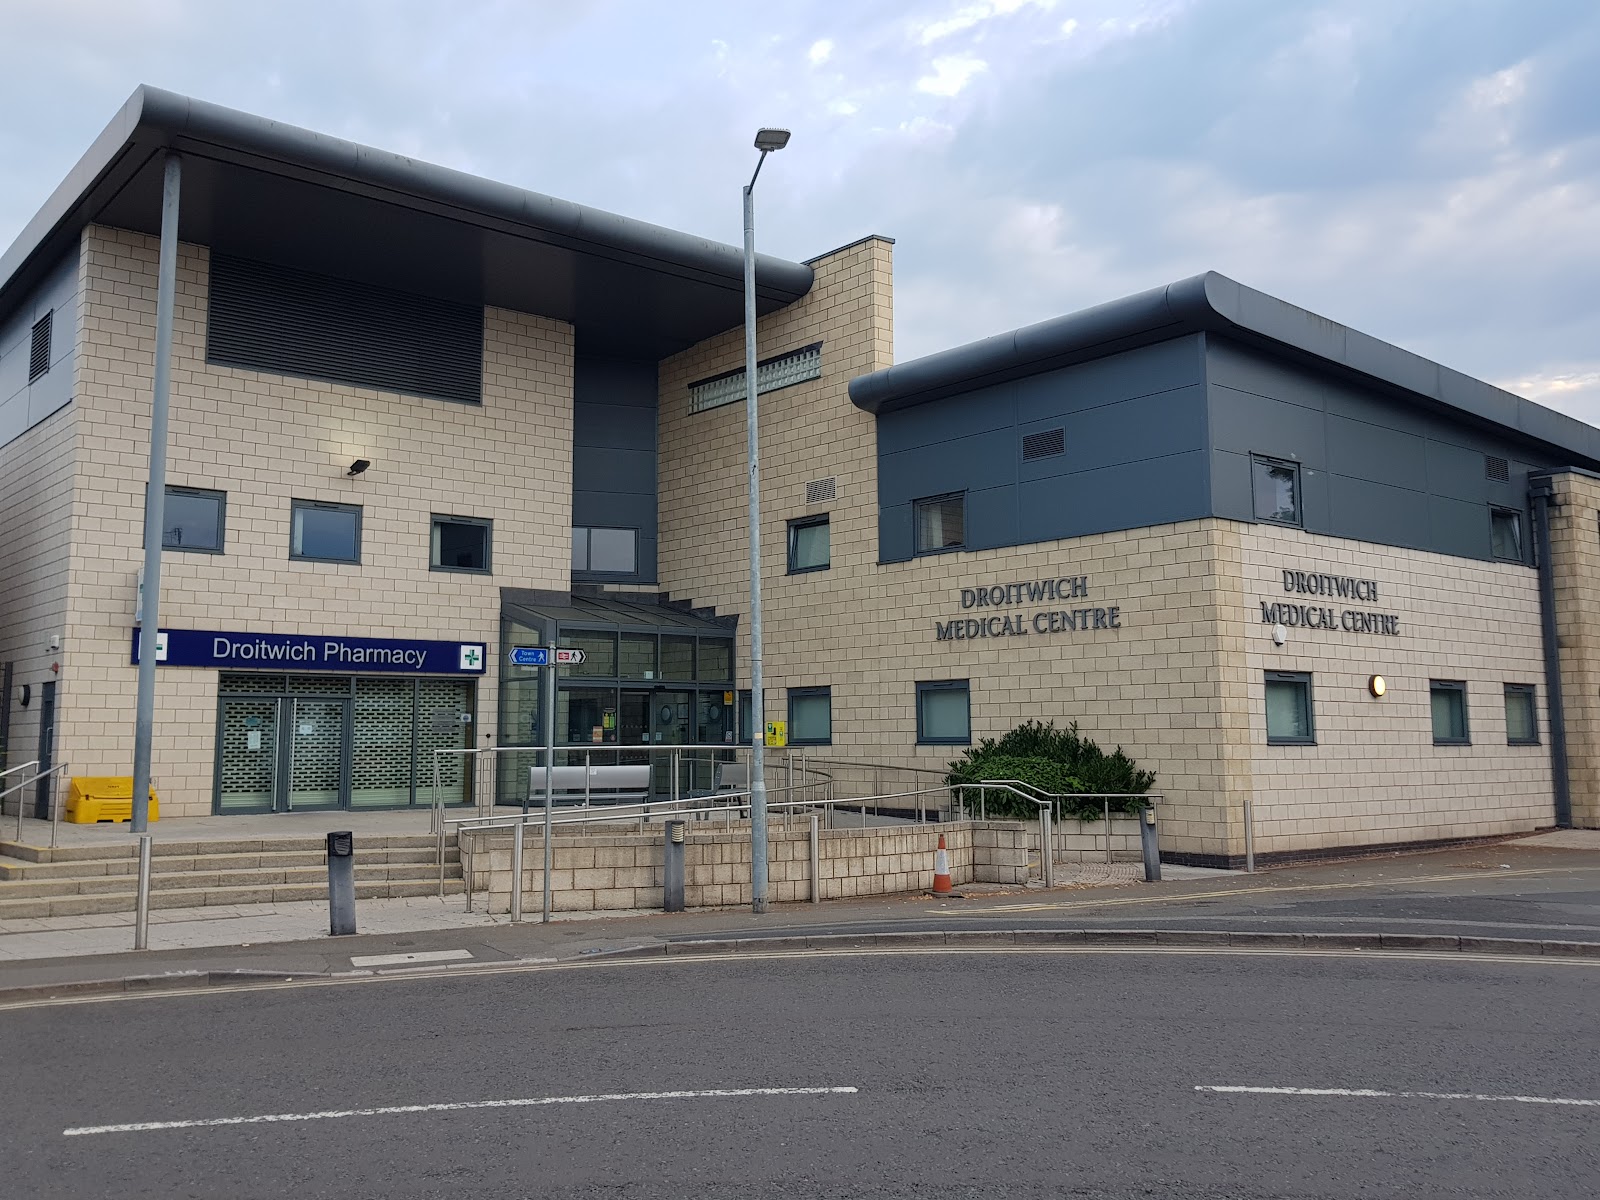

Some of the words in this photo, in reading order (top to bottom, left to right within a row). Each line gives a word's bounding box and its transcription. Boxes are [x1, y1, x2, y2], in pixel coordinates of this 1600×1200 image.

[960, 576, 1088, 609] DROITWICH
[1282, 569, 1379, 602] DROITWICH
[935, 614, 1027, 641] MEDICAL
[1032, 606, 1122, 634] CENTRE
[1260, 601, 1339, 630] MEDICAL
[1341, 609, 1400, 636] CENTRE
[213, 637, 316, 662] Droitwich
[323, 641, 427, 669] Pharmacy
